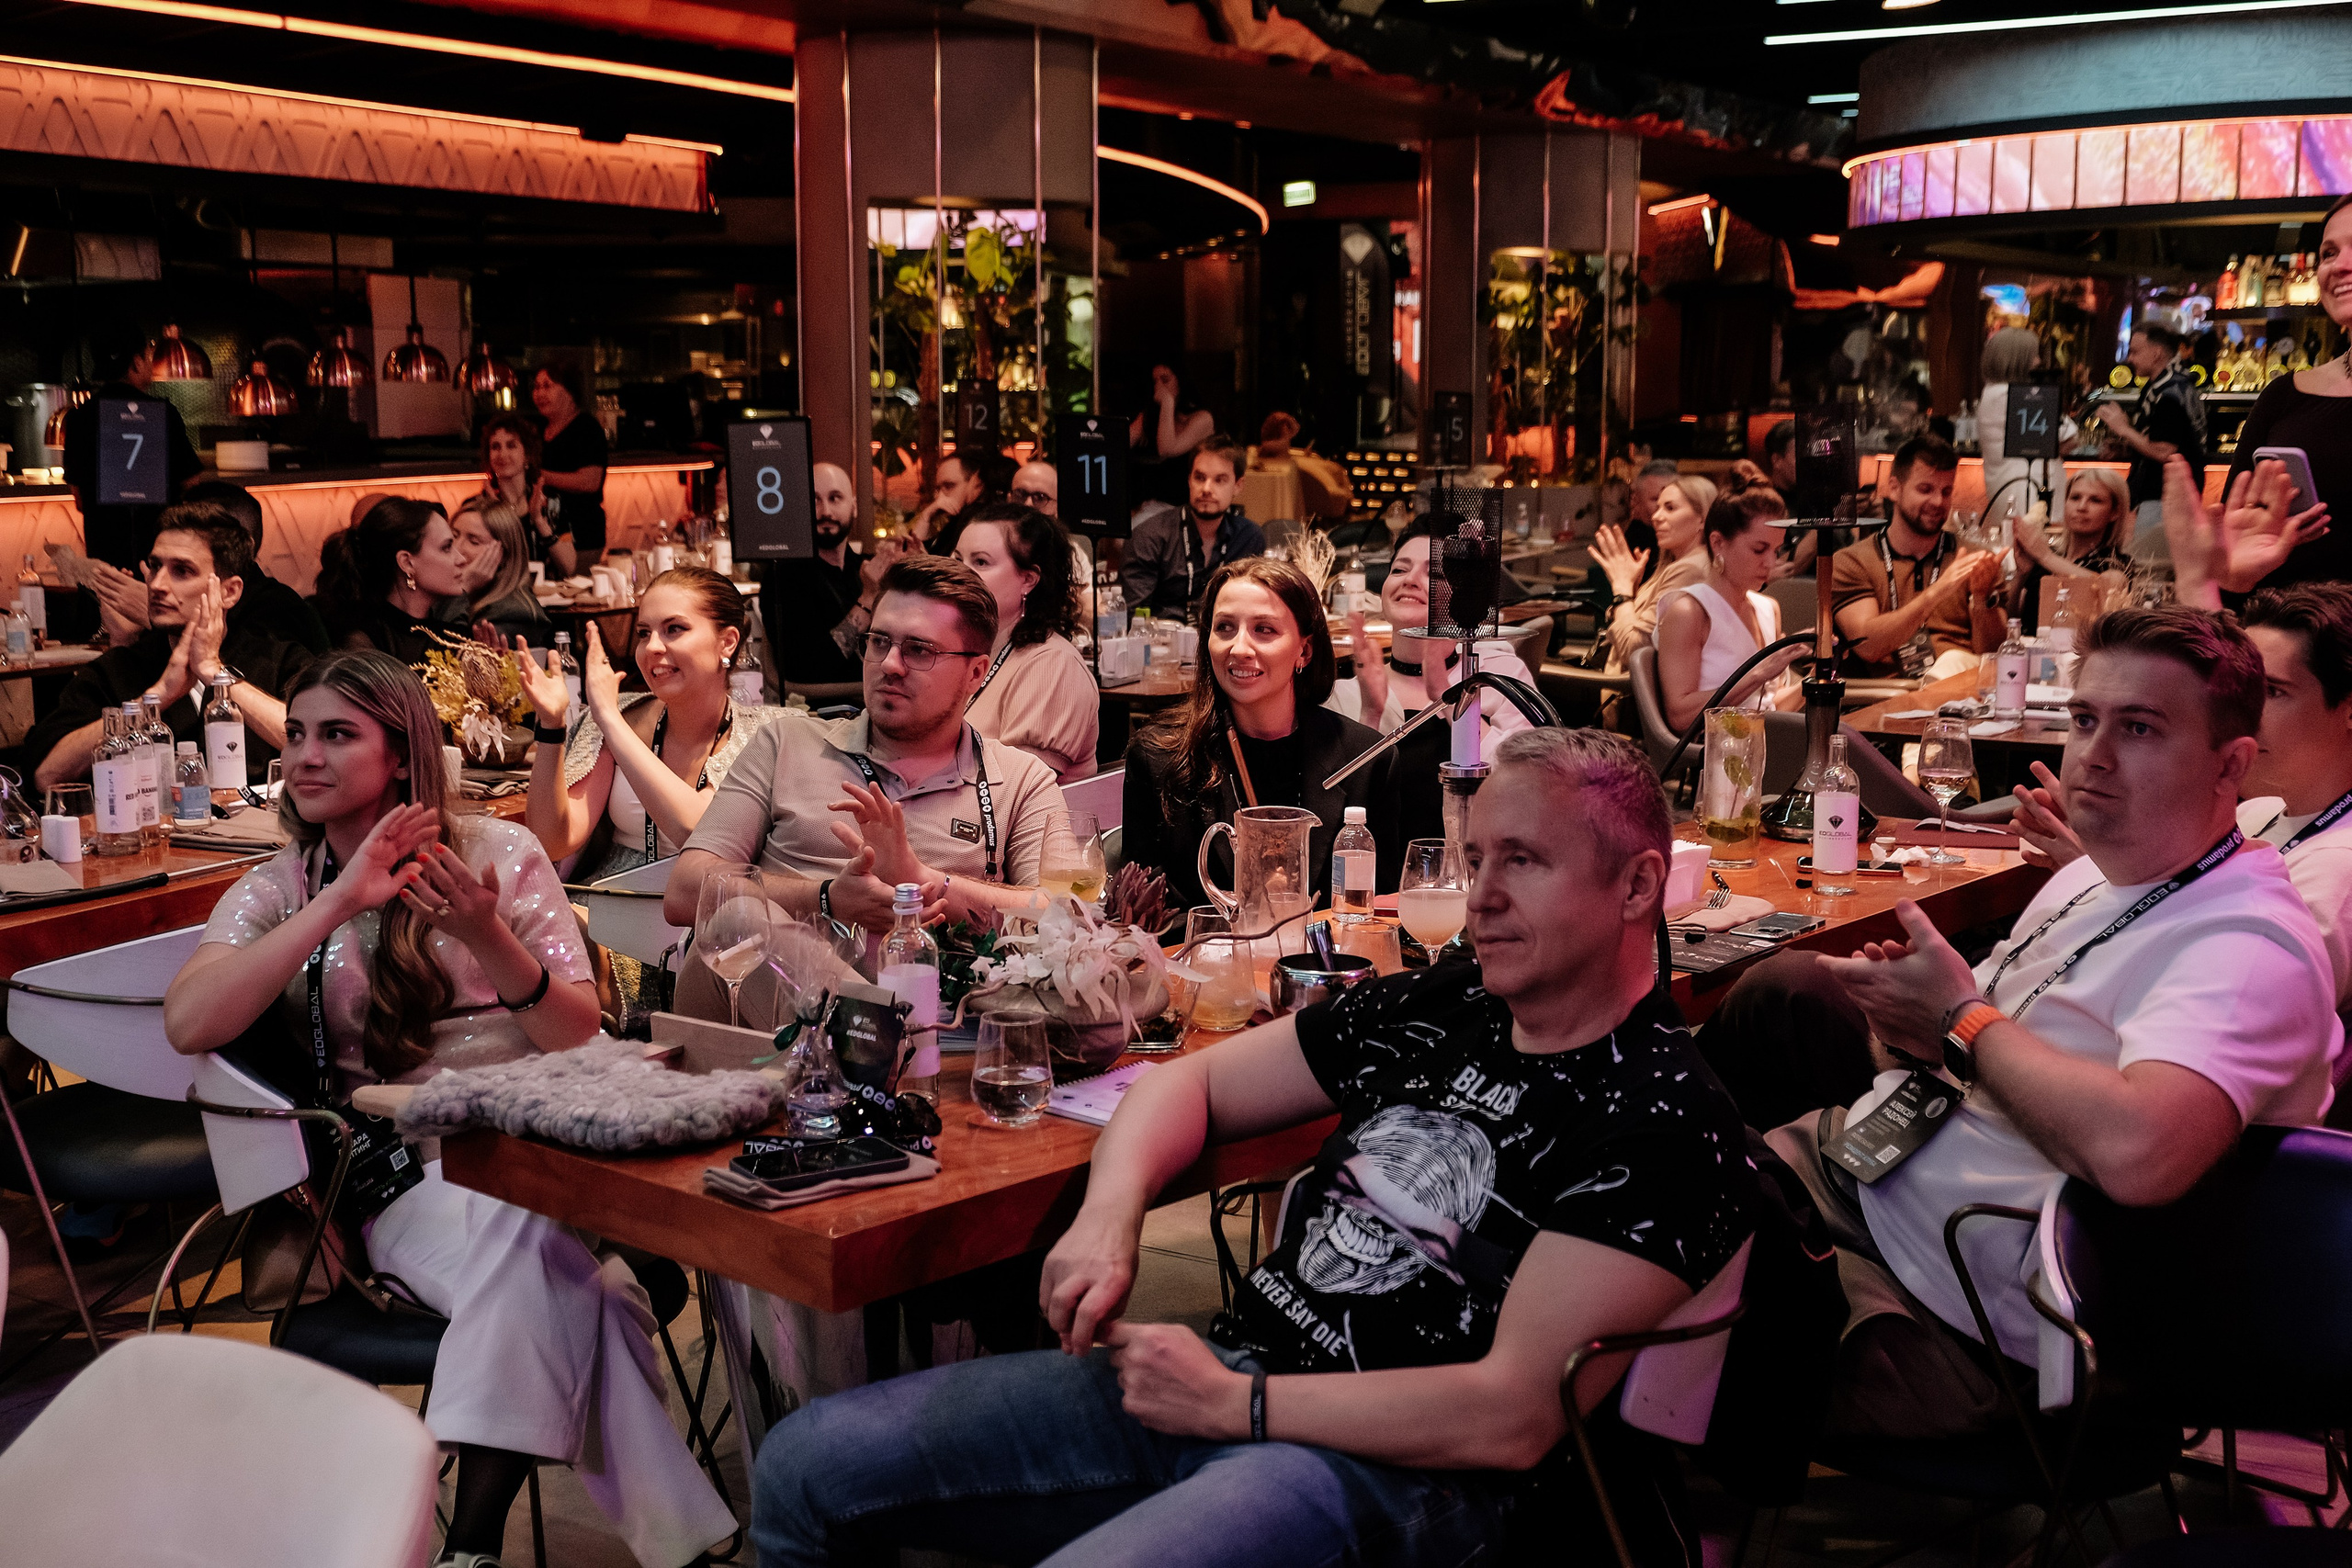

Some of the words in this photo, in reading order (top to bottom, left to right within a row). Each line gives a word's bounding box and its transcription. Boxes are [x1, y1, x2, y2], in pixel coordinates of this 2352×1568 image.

[965, 404, 988, 430] 12
[2016, 408, 2049, 436] 14
[121, 434, 144, 470] 7
[756, 466, 784, 514] 8
[1077, 454, 1107, 495] 11
[983, 814, 997, 847] prodamus
[2196, 837, 2236, 872] prodamus
[2095, 886, 2169, 940] EDGLOBAL
[310, 986, 325, 1056] EDGLOBAL
[1250, 1266, 1293, 1310] NEVER
[1284, 1300, 1318, 1329] SAY
[1311, 1321, 1347, 1357] DIE
